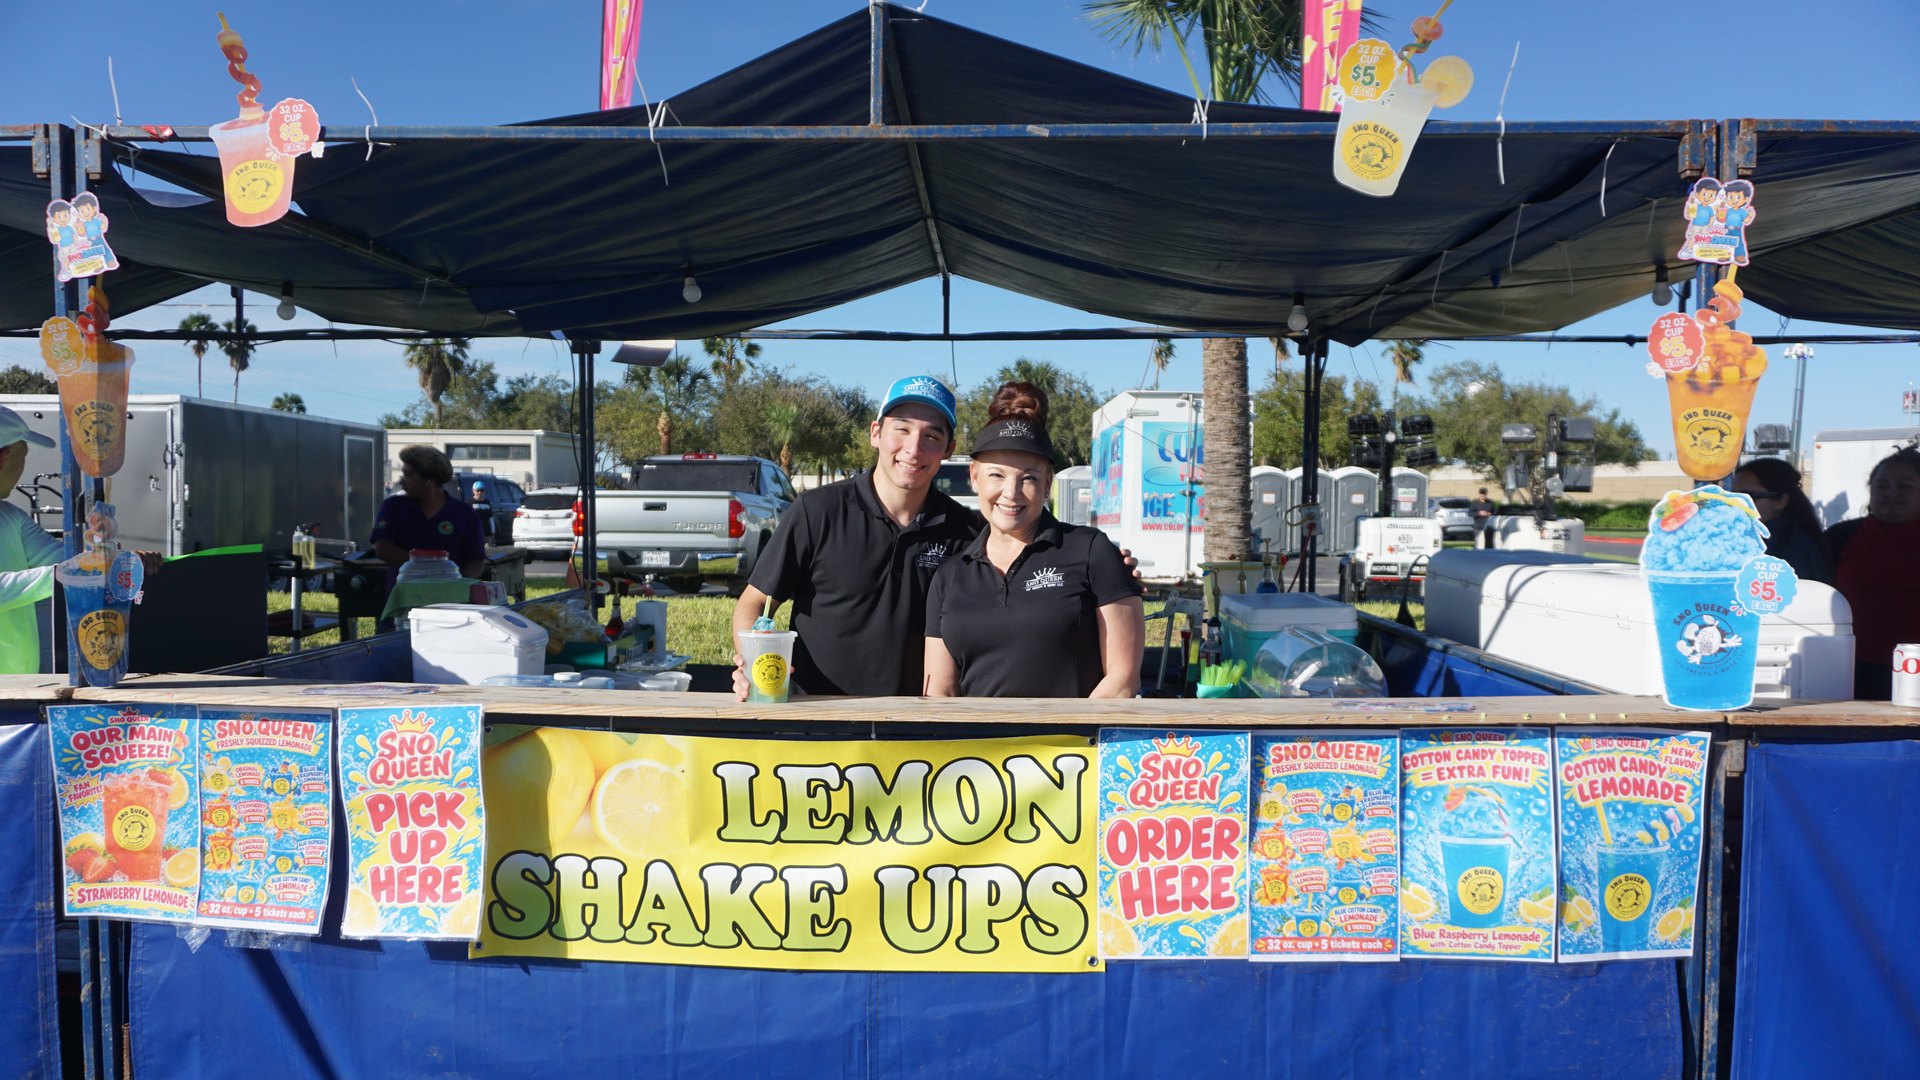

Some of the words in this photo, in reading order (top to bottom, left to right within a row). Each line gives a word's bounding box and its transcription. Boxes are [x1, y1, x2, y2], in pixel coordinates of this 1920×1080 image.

[1358, 44, 1371, 55] 32
[1360, 55, 1380, 65] CUP
[280, 106, 291, 114] 32
[284, 114, 302, 123] CUP
[1352, 124, 1369, 133] SNO
[1372, 124, 1400, 144] QUEEN
[284, 142, 306, 152] EACH
[235, 165, 249, 176] SNO
[1694, 235, 1712, 243] SNO
[1659, 318, 1672, 329] 32
[53, 331, 68, 342] CUP
[1664, 328, 1684, 338] CUP
[1665, 356, 1691, 368] EACH
[74, 404, 87, 417] SNO
[1683, 411, 1699, 422] SNO
[1703, 408, 1734, 422] QUEEN
[1143, 491, 1175, 518] ICE
[672, 521, 726, 530] TUNDRA
[1754, 562, 1767, 570] 32
[1758, 571, 1778, 580] CUP
[1750, 579, 1782, 602] $5.
[1752, 600, 1778, 611] EACH
[1673, 609, 1692, 626] SNO
[1695, 603, 1730, 616] QUEEN
[81, 616, 94, 630] SNO
[109, 716, 126, 724] SNO
[216, 720, 254, 739] SNO
[257, 718, 315, 741] QUEEN
[72, 727, 123, 751] OUR
[128, 725, 173, 743] MAIN
[378, 731, 435, 758] SNO
[1454, 733, 1472, 742] SNO
[1475, 732, 1505, 743] QUEEN
[1595, 738, 1614, 749] SNO
[1616, 738, 1648, 750] QUEEN
[216, 740, 245, 750] FRESHLY
[246, 738, 277, 746] SQUEEZED
[278, 739, 313, 752] LEMONADE
[1670, 746, 1696, 758] NEW
[83, 743, 171, 769] SQUEEZE!
[1270, 743, 1313, 764] SNO
[1316, 741, 1381, 763] QUEEN
[1402, 750, 1451, 771] COTTON
[1455, 748, 1497, 762] CANDY
[1501, 749, 1547, 767] TOPPER
[369, 749, 452, 786] QUEEN
[1140, 752, 1204, 783] SNO
[1271, 762, 1302, 775] FRESHLY
[1304, 761, 1339, 770] SQUEEZED
[1340, 763, 1379, 775] LEMONADE
[1564, 756, 1616, 782] COTTON
[1619, 755, 1668, 779] CANDY
[1664, 755, 1701, 771] FLAVOR!
[1436, 764, 1487, 782] EXTRA
[1491, 764, 1530, 783] FUN!
[68, 785, 103, 802] FAVORITE!
[73, 781, 91, 793] FAN
[1129, 774, 1220, 808] QUEEN
[1577, 776, 1688, 803] LEMONADE
[713, 753, 1089, 846] LEMON
[1291, 791, 1317, 799] ORIGINAL
[1291, 798, 1320, 806] LEMONADE
[118, 810, 129, 821] SNO
[130, 807, 149, 819] QUEEN
[365, 791, 466, 833] PICK
[390, 829, 447, 865] UP
[1106, 816, 1241, 867] ORDER
[1461, 872, 1473, 884] SNO
[1474, 868, 1497, 877] QUEEN
[1610, 879, 1623, 890] SNO
[1624, 876, 1645, 885] QUEEN
[274, 883, 308, 892] LEMONADE
[369, 865, 464, 904] HERE
[77, 886, 141, 904] STRAWBERRY
[143, 888, 189, 909] LEMONADE
[1119, 864, 1237, 921] HERE
[487, 850, 852, 953] SHAKE
[874, 862, 1090, 955] UPS
[208, 903, 220, 914] 32
[234, 906, 248, 917] cup
[255, 906, 262, 917] 5
[263, 907, 288, 918] tickets
[288, 910, 306, 919] each
[1339, 913, 1379, 923] LEMONADE
[1412, 928, 1436, 940] Blue
[1439, 928, 1489, 941] Raspberry
[1492, 929, 1541, 943] Lemonade
[1267, 939, 1280, 950] 32
[1297, 940, 1312, 951] cup
[1321, 939, 1328, 950] 5
[1330, 939, 1361, 949] tickets
[1362, 939, 1383, 949] each
[1429, 941, 1446, 949] with
[1448, 941, 1471, 949] Cotton
[1474, 942, 1496, 951] Candy
[1497, 942, 1522, 952] Topper
